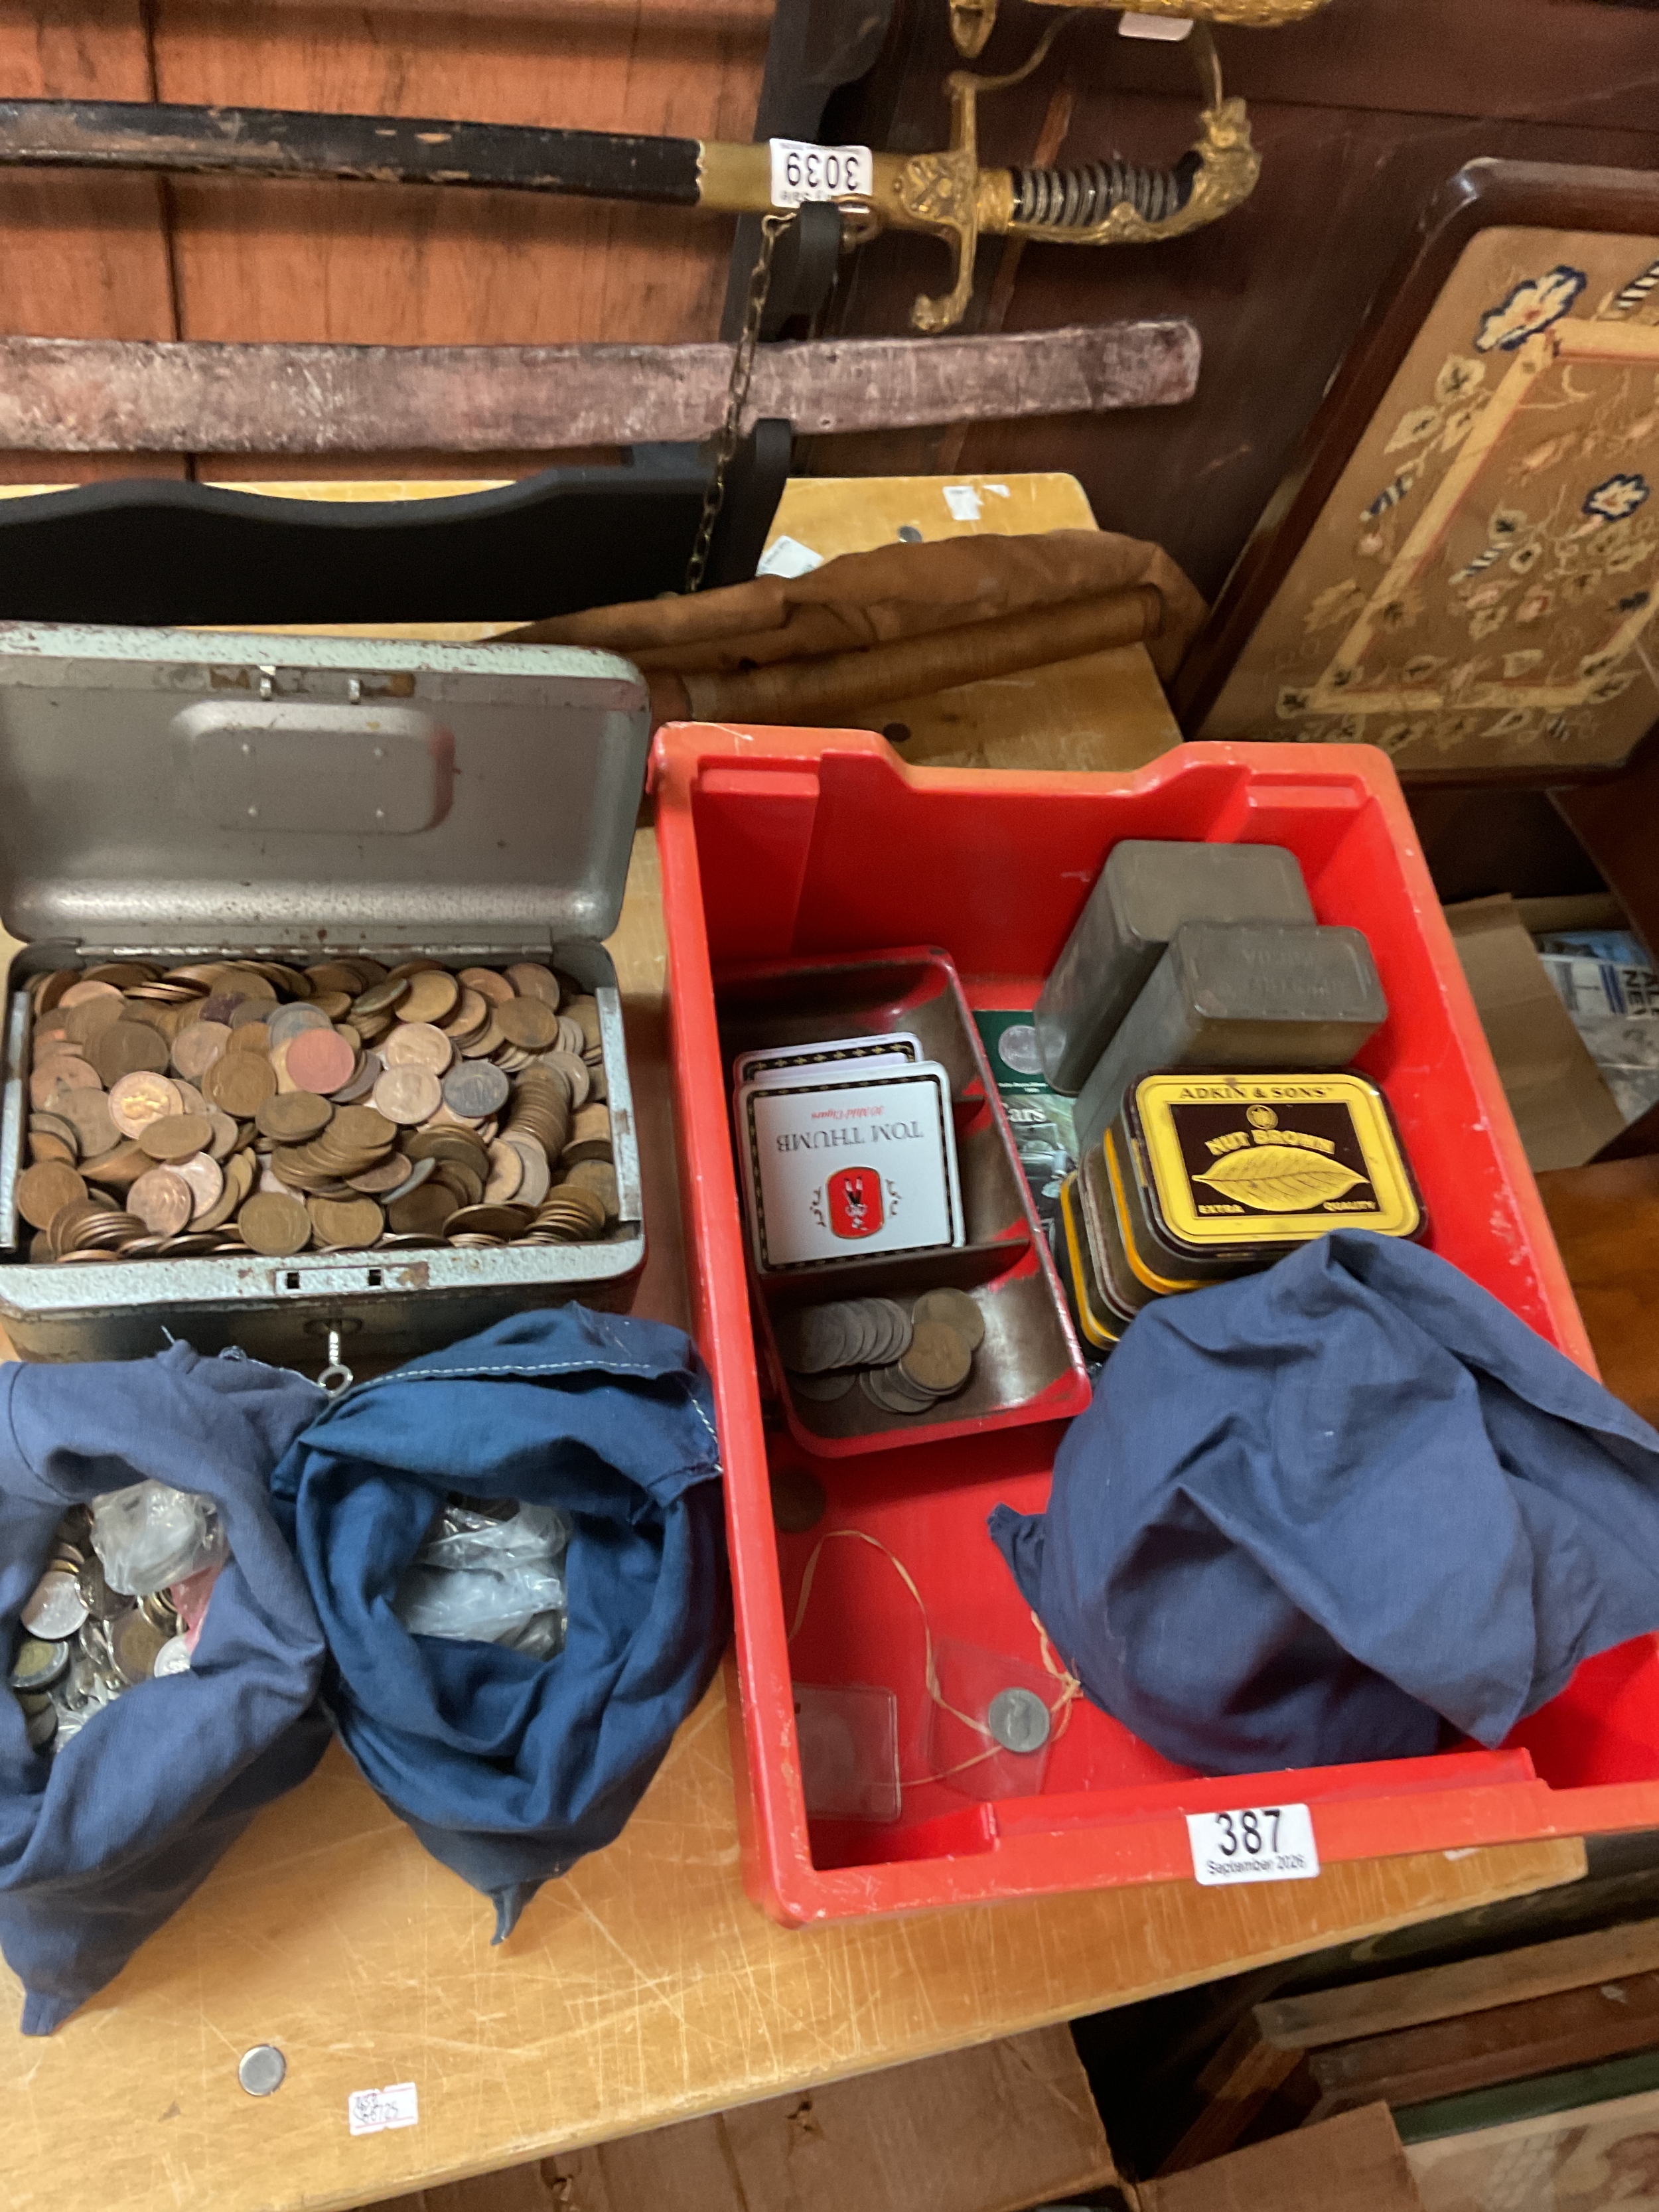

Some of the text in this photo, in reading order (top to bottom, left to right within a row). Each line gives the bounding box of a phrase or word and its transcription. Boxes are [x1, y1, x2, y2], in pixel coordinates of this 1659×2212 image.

[786, 153, 859, 191] 3039
[1179, 1087, 1246, 1099] ADKIN
[1254, 1087, 1268, 1099] &
[811, 1108, 844, 1120] Cigars
[776, 1120, 924, 1153] TOM THUMB
[1204, 1129, 1335, 1156] NUT BROWN
[1198, 1204, 1246, 1214] EXTRA
[1323, 1201, 1376, 1212] QUALITY
[1216, 1809, 1281, 1856] 387
[1207, 1854, 1307, 1876] September 2026
